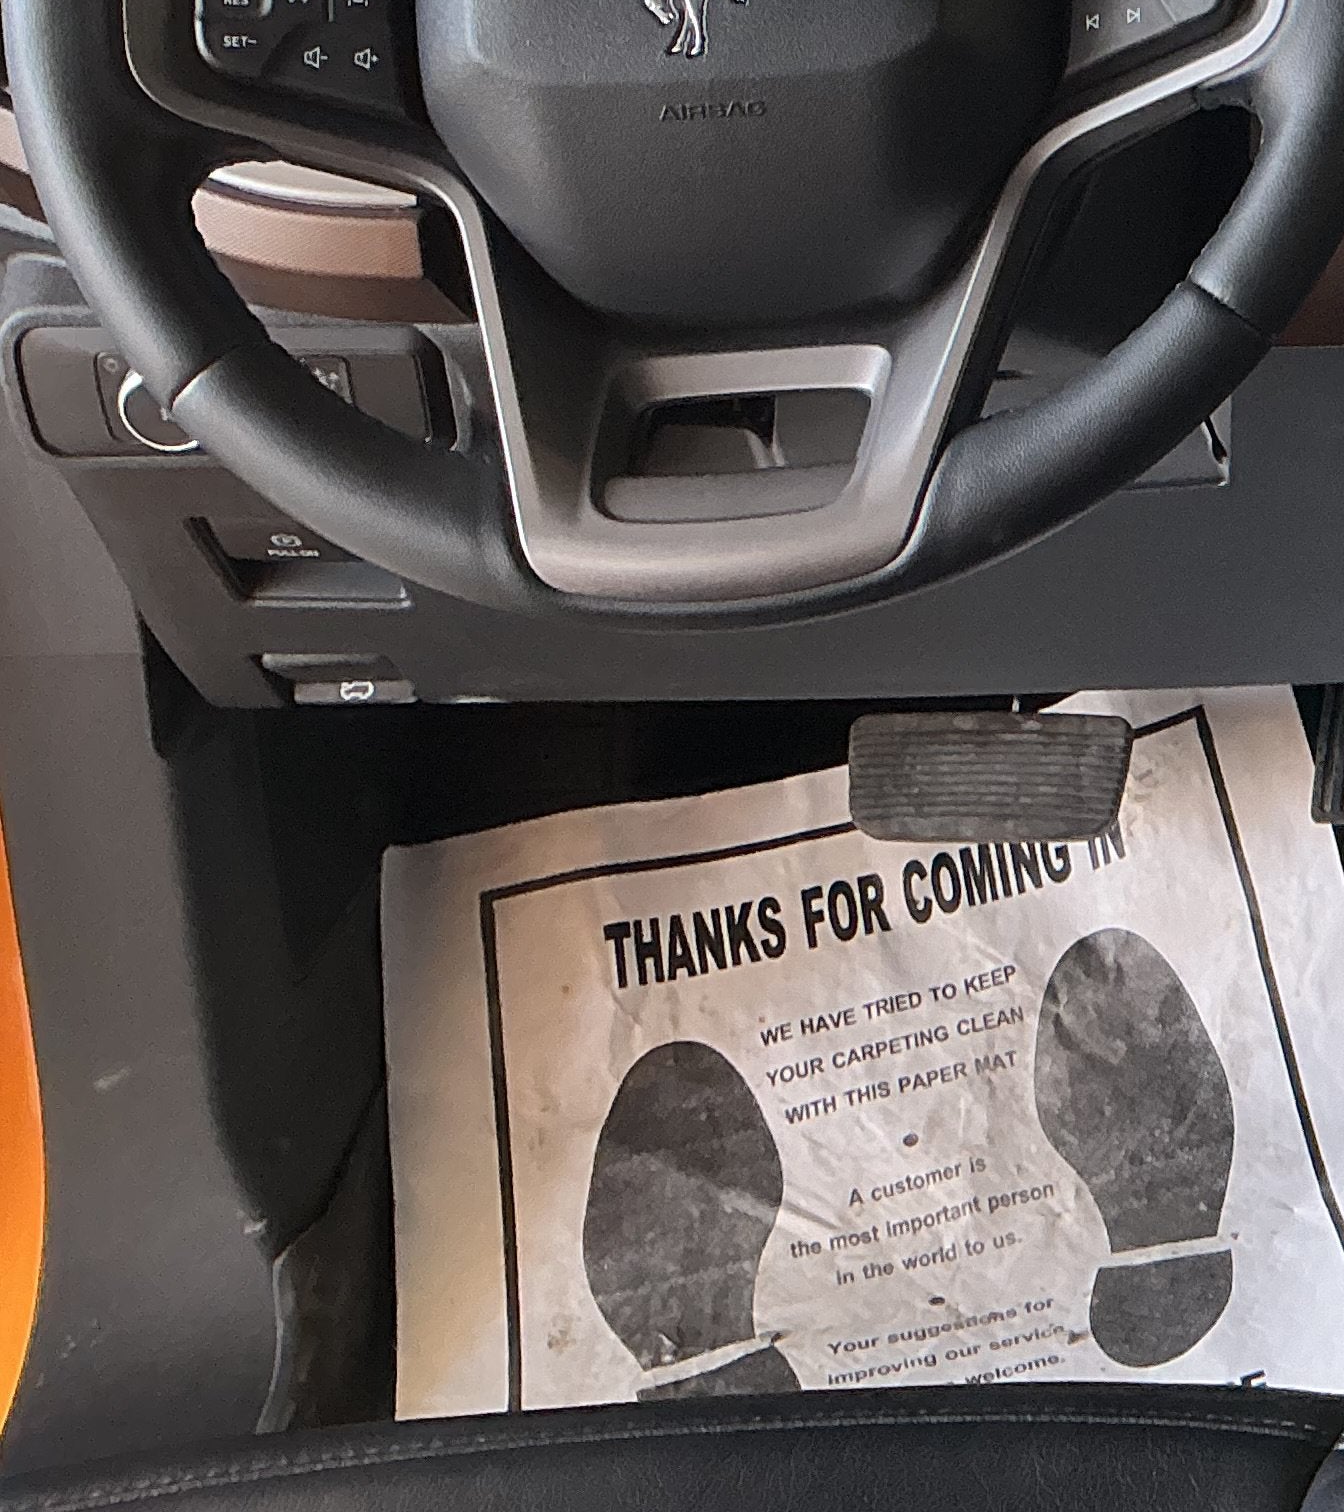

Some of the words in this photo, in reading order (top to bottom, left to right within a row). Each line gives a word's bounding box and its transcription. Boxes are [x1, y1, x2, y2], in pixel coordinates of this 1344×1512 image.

[659, 101, 766, 120] AIRBAG
[603, 897, 788, 990] THANKS
[800, 873, 891, 949] FOR
[901, 841, 1073, 924] COMING
[1087, 824, 1126, 871] IN
[759, 1025, 793, 1048] WE
[800, 1006, 857, 1038] HAVE
[863, 992, 923, 1022] TRIED
[930, 982, 958, 1003] TO
[963, 964, 1018, 996] KEEP
[766, 1053, 826, 1087] YOUR
[831, 1028, 949, 1069] CARPETING
[957, 1004, 1025, 1038] CLEAN
[784, 1093, 838, 1126] WITH
[844, 1077, 893, 1108] THIS
[898, 1063, 968, 1098] PAPER
[975, 1048, 1018, 1077] MAT
[847, 1189, 865, 1207] A
[870, 1164, 963, 1202] customer
[969, 1155, 988, 1175] is
[789, 1236, 823, 1260] the
[828, 1222, 880, 1249] most
[885, 1197, 982, 1236] important
[988, 1182, 1055, 1215] person
[861, 1257, 895, 1281] the
[901, 1245, 958, 1274] world
[964, 1238, 985, 1258] to
[992, 1231, 1023, 1253] us.
[827, 1333, 882, 1356] Your
[1023, 1297, 1055, 1315] for
[944, 1340, 983, 1363] our
[965, 1353, 1066, 1386] welcome.
